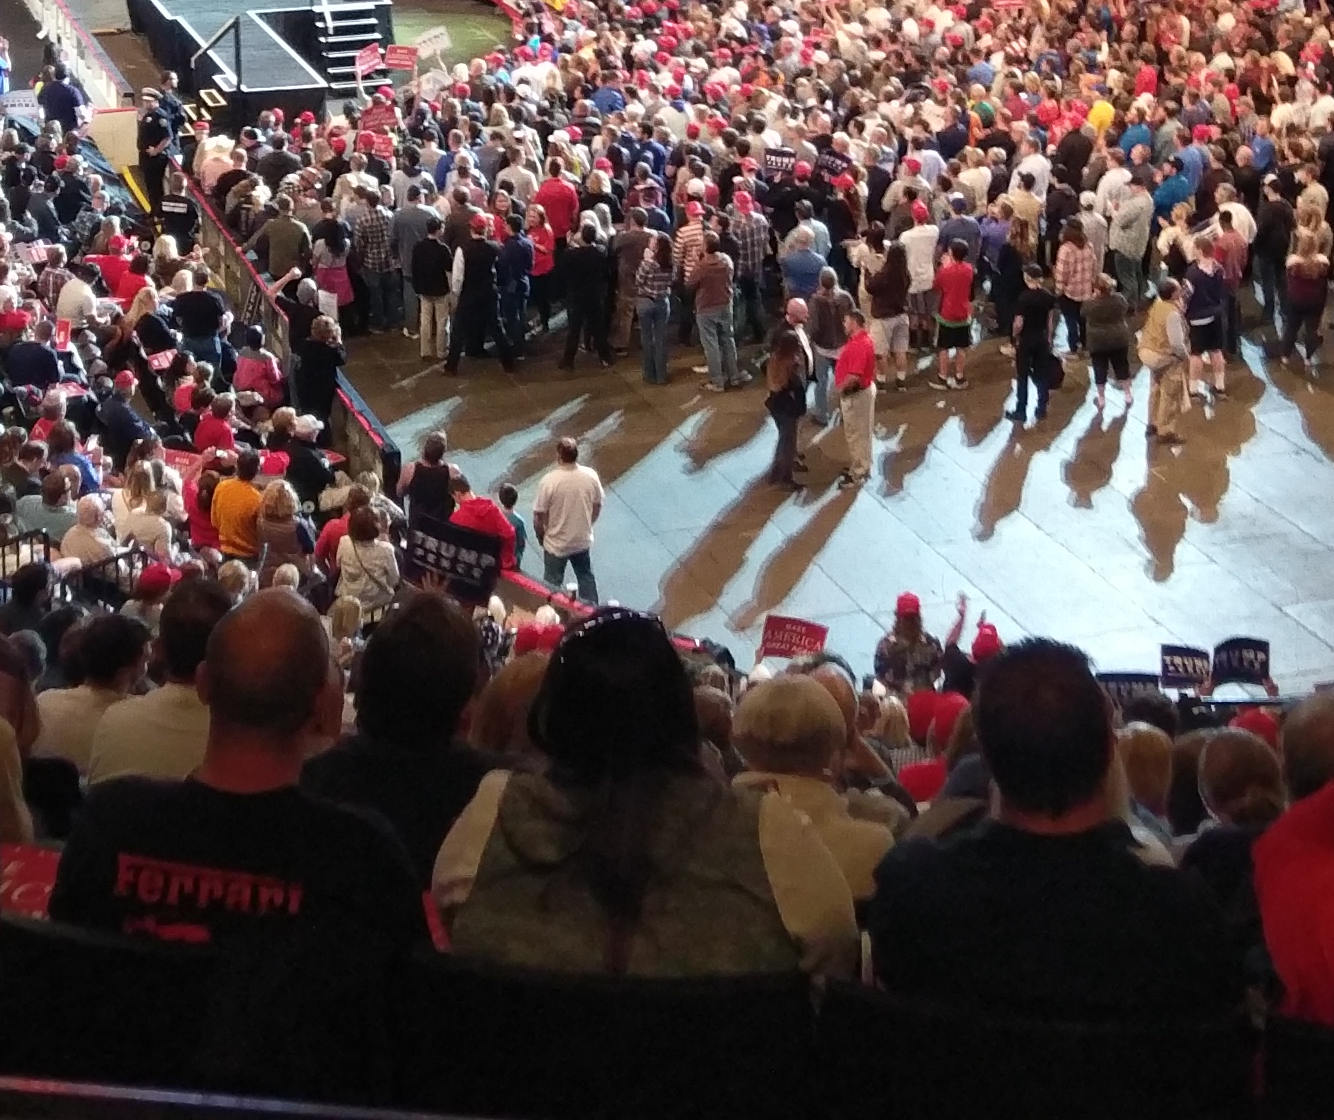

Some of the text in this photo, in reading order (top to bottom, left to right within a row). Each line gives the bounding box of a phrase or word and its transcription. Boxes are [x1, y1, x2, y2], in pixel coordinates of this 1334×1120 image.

[412, 529, 496, 569] TRUMP
[414, 547, 483, 579] PENCE
[764, 629, 822, 652] AMERICA
[115, 853, 302, 916] Ferrari
